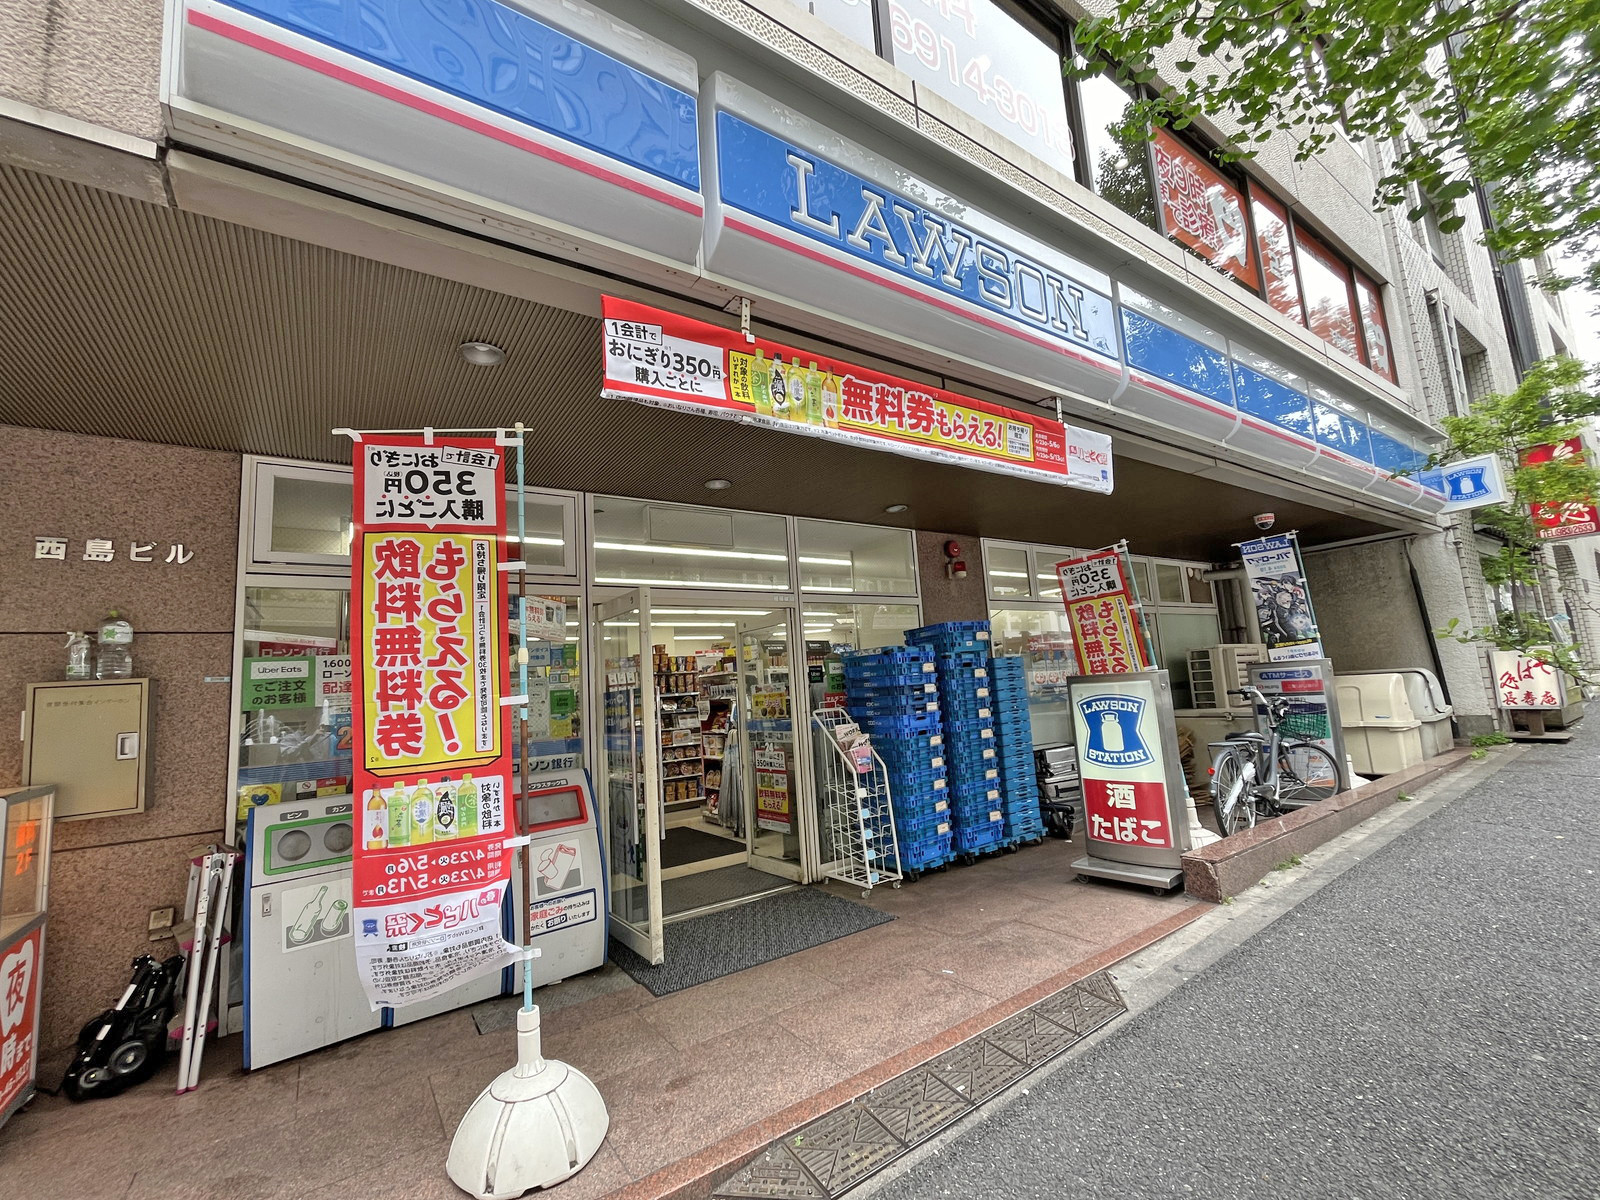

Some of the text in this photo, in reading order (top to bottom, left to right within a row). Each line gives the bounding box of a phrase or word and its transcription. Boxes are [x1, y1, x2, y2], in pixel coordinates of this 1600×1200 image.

[787, 149, 1089, 342] LAWSON
[611, 321, 657, 342] 1会計で
[635, 366, 703, 394] 購入ごとに
[740, 357, 751, 401] 対象の飲料
[1447, 469, 1482, 481] LAWSON
[1452, 488, 1486, 500] STATION
[34, 536, 195, 564] 西島ビル
[258, 666, 279, 674] Uber
[252, 680, 307, 693] でご注文
[252, 692, 307, 705] のお客様
[1502, 690, 1557, 706] 長寿庵
[1082, 700, 1139, 714] LAWSON
[1089, 749, 1146, 763] STATION
[512, 757, 573, 774] ロソン銀行
[1106, 782, 1137, 810] 酒
[1091, 813, 1165, 845] たばこ
[6, 959, 27, 1018] 夜
